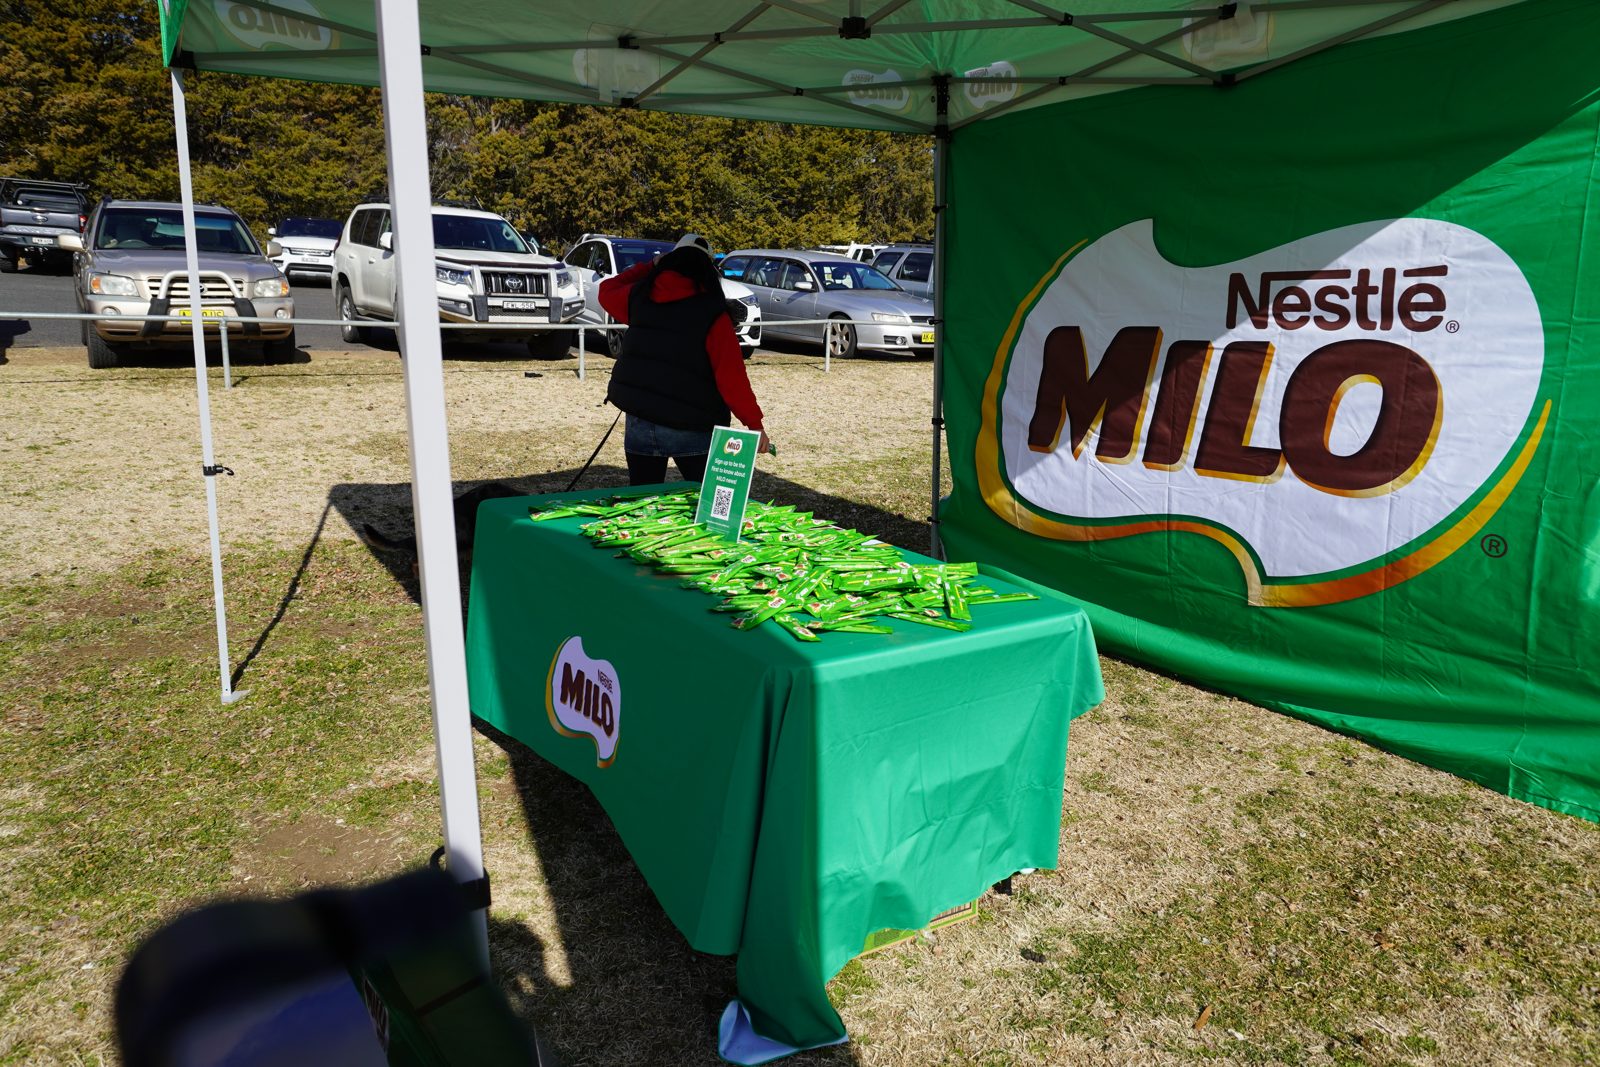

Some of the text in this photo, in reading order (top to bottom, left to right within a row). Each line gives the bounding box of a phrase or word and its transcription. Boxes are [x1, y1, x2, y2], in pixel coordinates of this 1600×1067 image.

[1225, 264, 1448, 333] Nestlé
[727, 442, 741, 450] MILO
[1028, 325, 1444, 499] MILO
[734, 470, 746, 478] about
[560, 661, 614, 737] MILO
